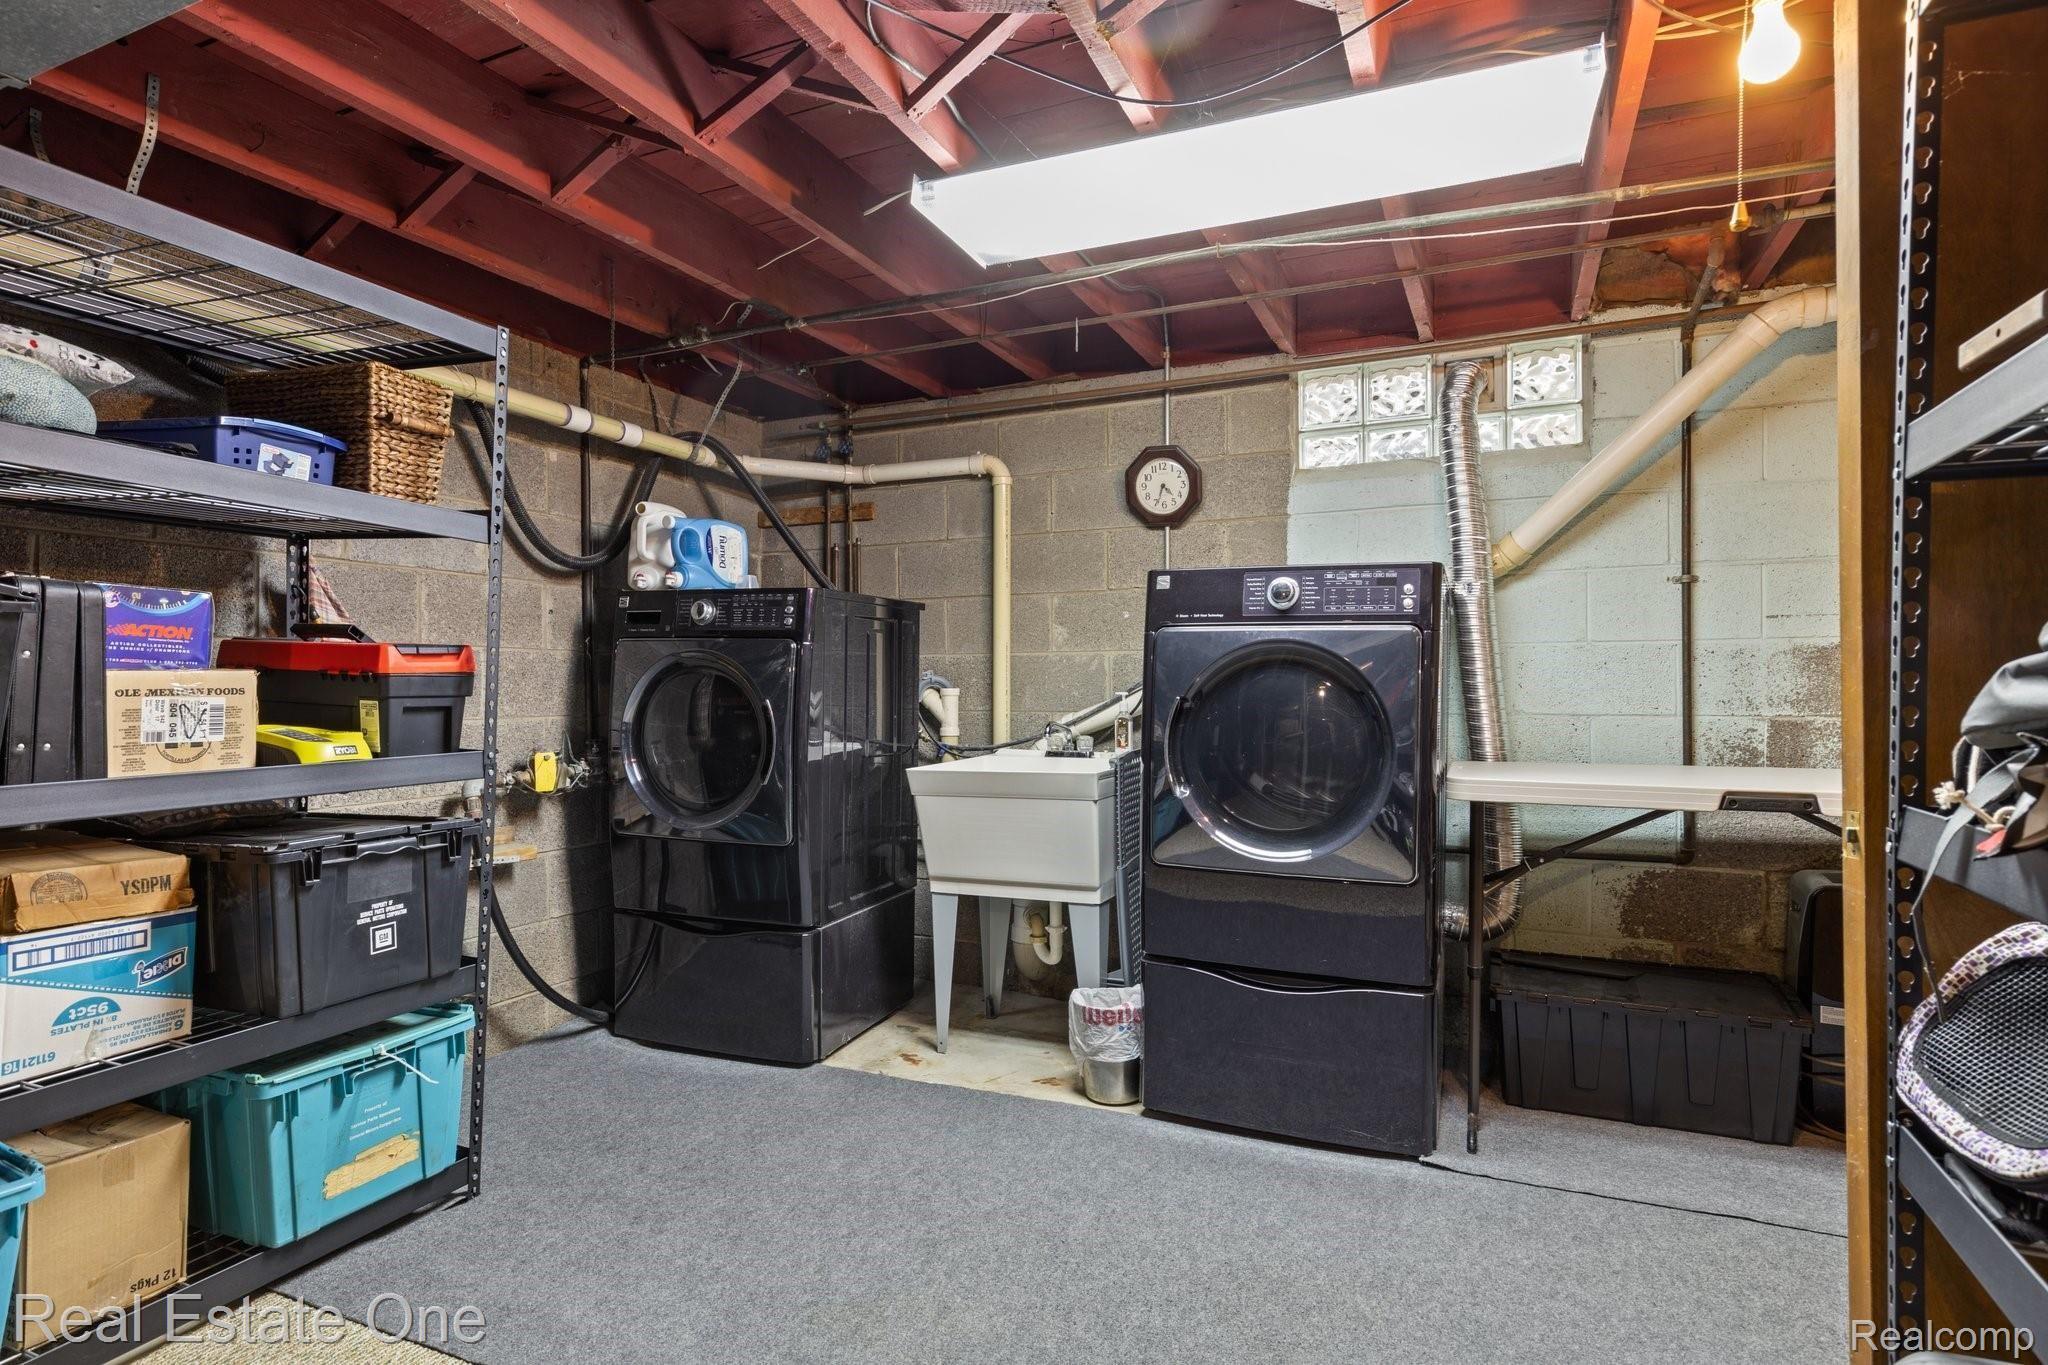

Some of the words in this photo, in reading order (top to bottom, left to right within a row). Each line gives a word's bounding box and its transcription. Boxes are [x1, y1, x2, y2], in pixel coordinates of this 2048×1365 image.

[1151, 465, 1157, 473] 11
[1159, 462, 1167, 471] 12
[1170, 464, 1174, 472] 1
[1144, 473, 1152, 482] 10
[1176, 469, 1182, 478] 2
[1141, 482, 1147, 491] 9
[1180, 481, 1186, 489] 3
[1145, 492, 1151, 500] 8
[1177, 491, 1182, 499] 4
[1153, 498, 1160, 507] 7
[1161, 501, 1168, 509] 6
[1170, 498, 1177, 506] 5
[719, 535, 728, 569] Downy
[124, 623, 194, 640] ACTION
[114, 688, 141, 697] OLE
[206, 687, 246, 696] FOODS
[169, 722, 177, 738] 045
[335, 747, 357, 755] RYOBI
[120, 874, 172, 896] YSDPM
[378, 932, 389, 941] GM
[69, 1001, 109, 1020] 95ct
[174, 1019, 184, 1030] 6
[50, 1022, 91, 1037] PLATES
[22, 1051, 56, 1069] 61121
[4, 1060, 18, 1075] 16
[163, 1267, 177, 1281] 12
[130, 1274, 160, 1293] Pkgs
